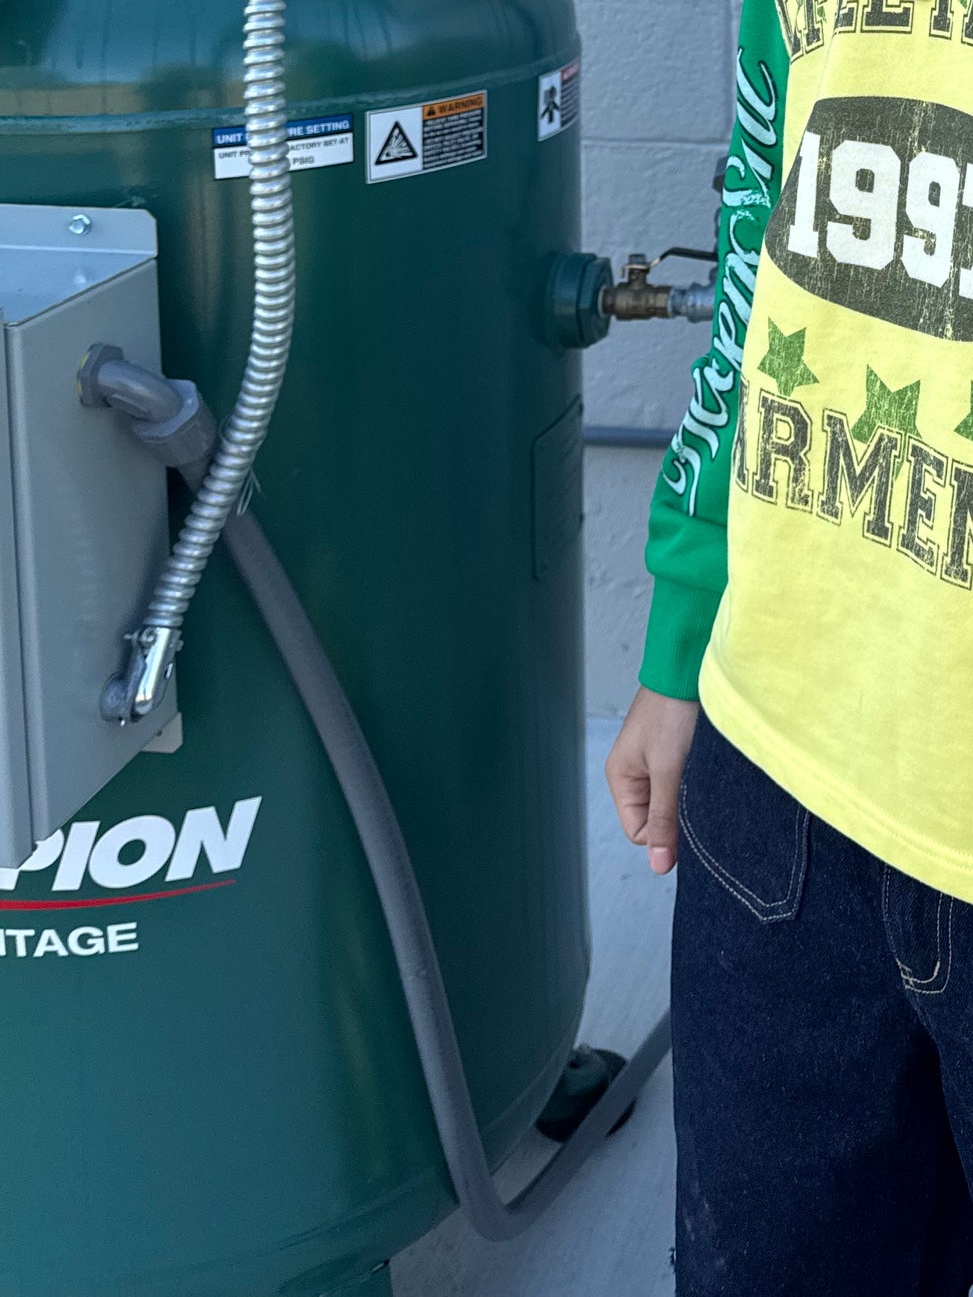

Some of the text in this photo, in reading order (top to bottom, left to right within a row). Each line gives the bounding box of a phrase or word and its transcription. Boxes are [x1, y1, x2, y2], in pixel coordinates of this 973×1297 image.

[438, 96, 482, 114] WARNING
[216, 132, 243, 145] UNIT
[306, 120, 350, 135] SETTING
[218, 151, 238, 159] UNIT
[290, 141, 320, 152] ACTORY
[0, 922, 139, 957] TAGE
